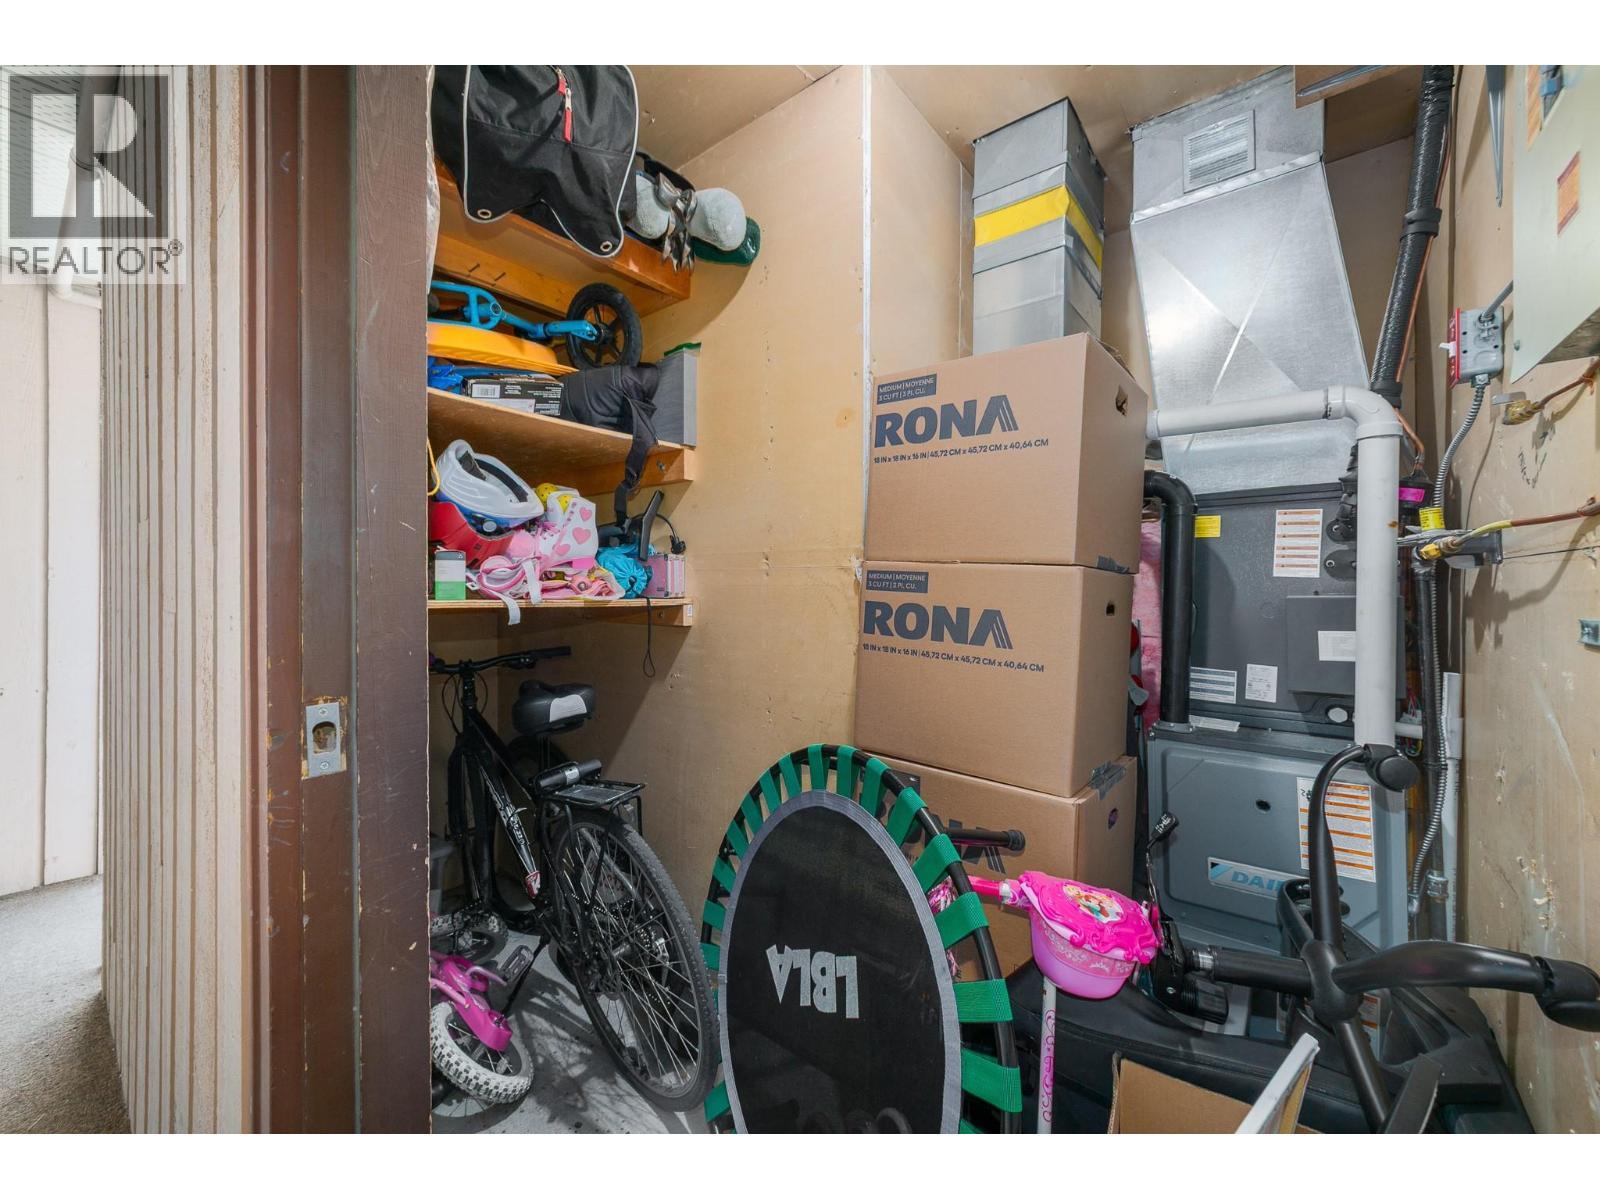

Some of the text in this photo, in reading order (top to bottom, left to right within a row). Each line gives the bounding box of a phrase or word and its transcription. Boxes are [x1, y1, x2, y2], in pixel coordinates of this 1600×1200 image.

[878, 384, 902, 392] MEDIUM
[906, 378, 934, 388] MOYENNE
[874, 394, 1019, 448] RONA
[930, 450, 948, 458] 45,72
[949, 448, 961, 456] CM
[968, 446, 988, 455] 45,72
[989, 444, 1002, 452] CM
[1009, 440, 1033, 450] 40,64
[1034, 438, 1049, 447] CM
[896, 574, 926, 582] MOYENNE
[863, 600, 1013, 649] RONA
[921, 650, 940, 660] 45,72
[941, 653, 953, 661] CM
[960, 655, 981, 664] 45,72
[982, 658, 996, 666] CM
[1003, 660, 1028, 670] 40,64
[1029, 664, 1044, 672] CM
[766, 944, 860, 1018] LBLA
